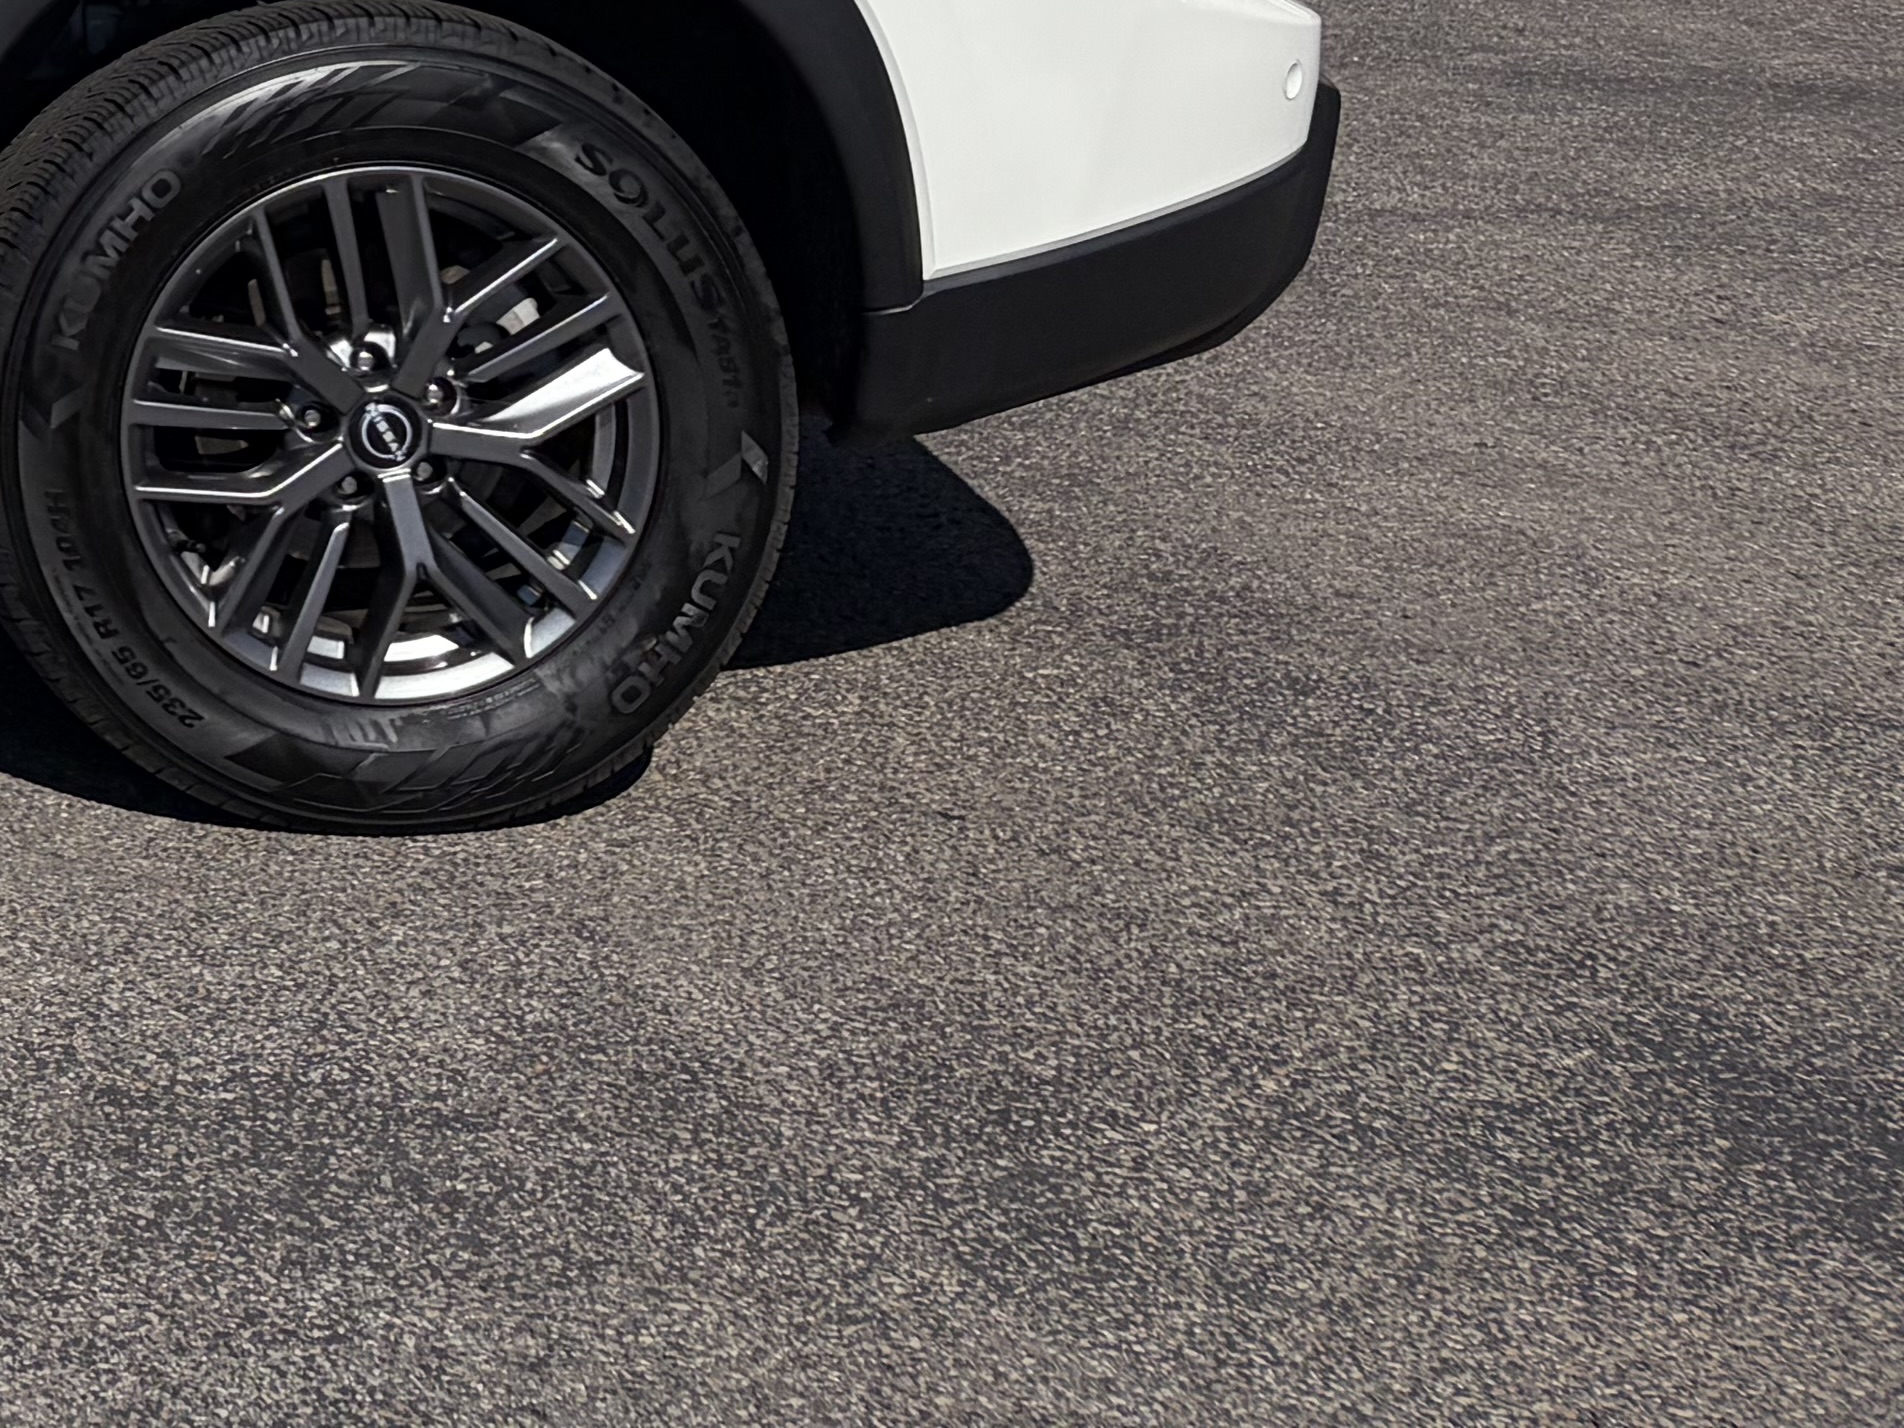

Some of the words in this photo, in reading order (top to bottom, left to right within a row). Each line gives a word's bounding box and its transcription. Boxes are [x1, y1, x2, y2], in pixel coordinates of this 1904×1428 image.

[50, 168, 182, 352] KUMHO
[574, 140, 725, 312] SOLUS
[361, 400, 408, 462] NISSAN
[73, 583, 119, 640] R17
[610, 530, 742, 715] KUMHO
[111, 645, 205, 729] 235/65
